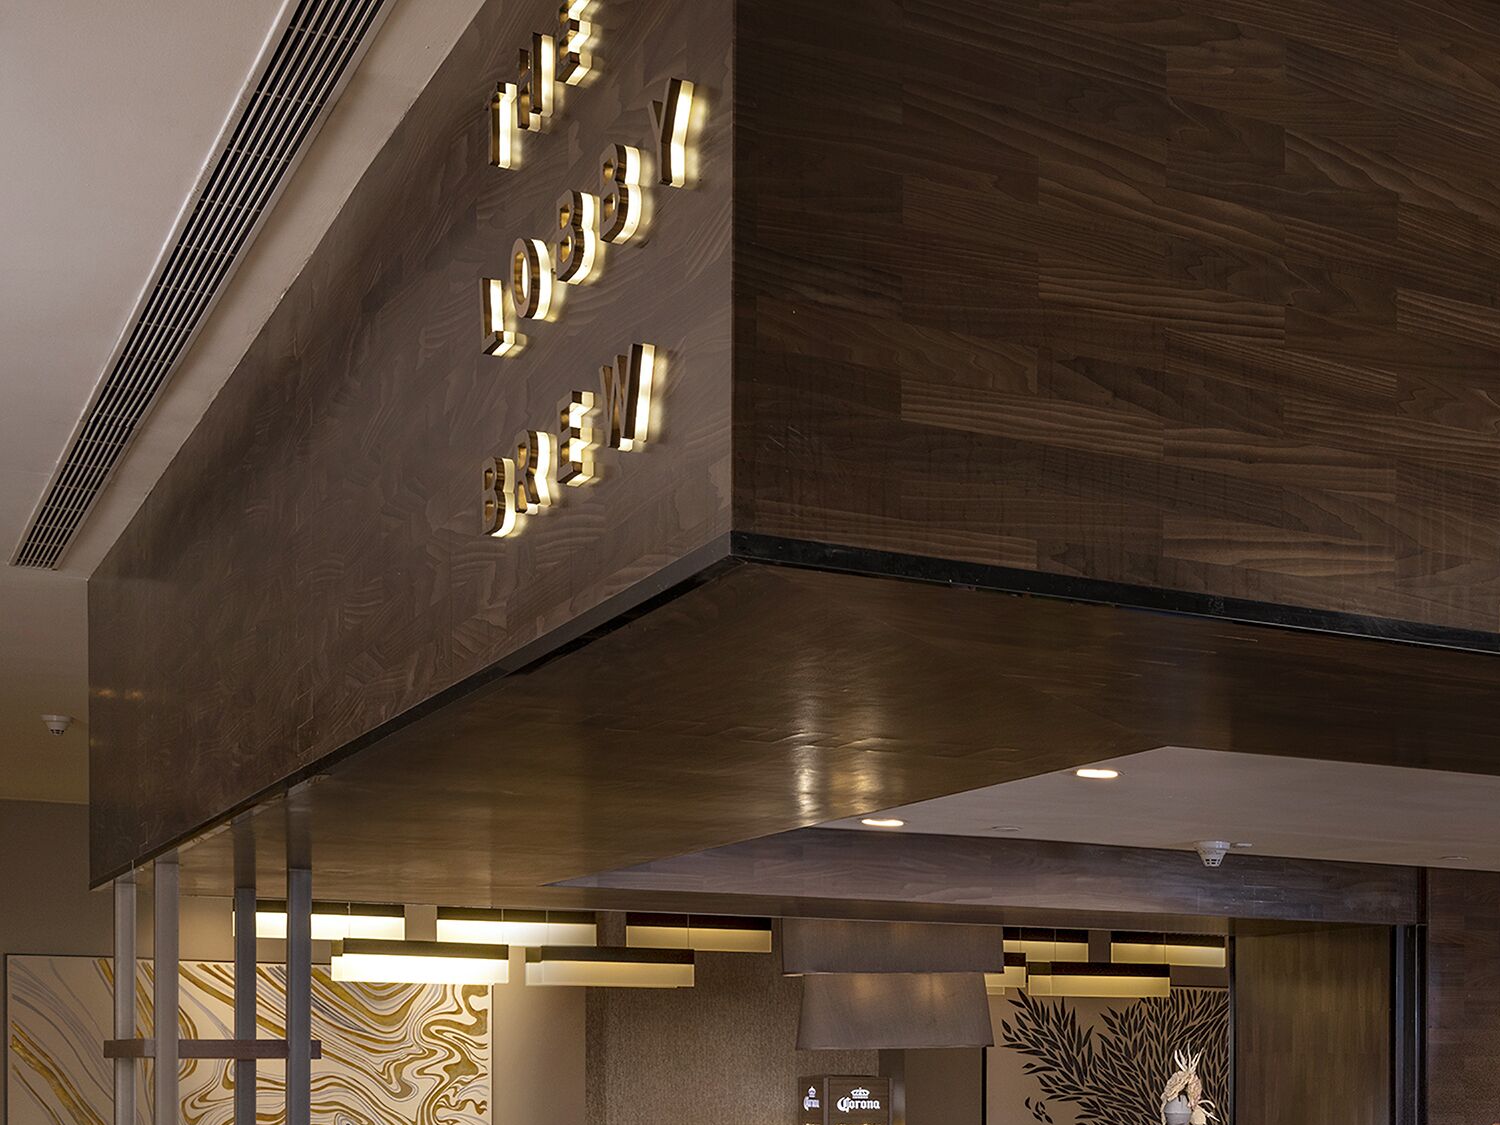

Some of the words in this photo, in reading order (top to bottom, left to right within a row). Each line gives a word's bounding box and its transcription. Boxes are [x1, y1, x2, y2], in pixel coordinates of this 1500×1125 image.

[487, 0, 592, 168] THE
[479, 77, 694, 357] LOBBY
[481, 343, 656, 539] BREW
[836, 1096, 881, 1113] Corona
